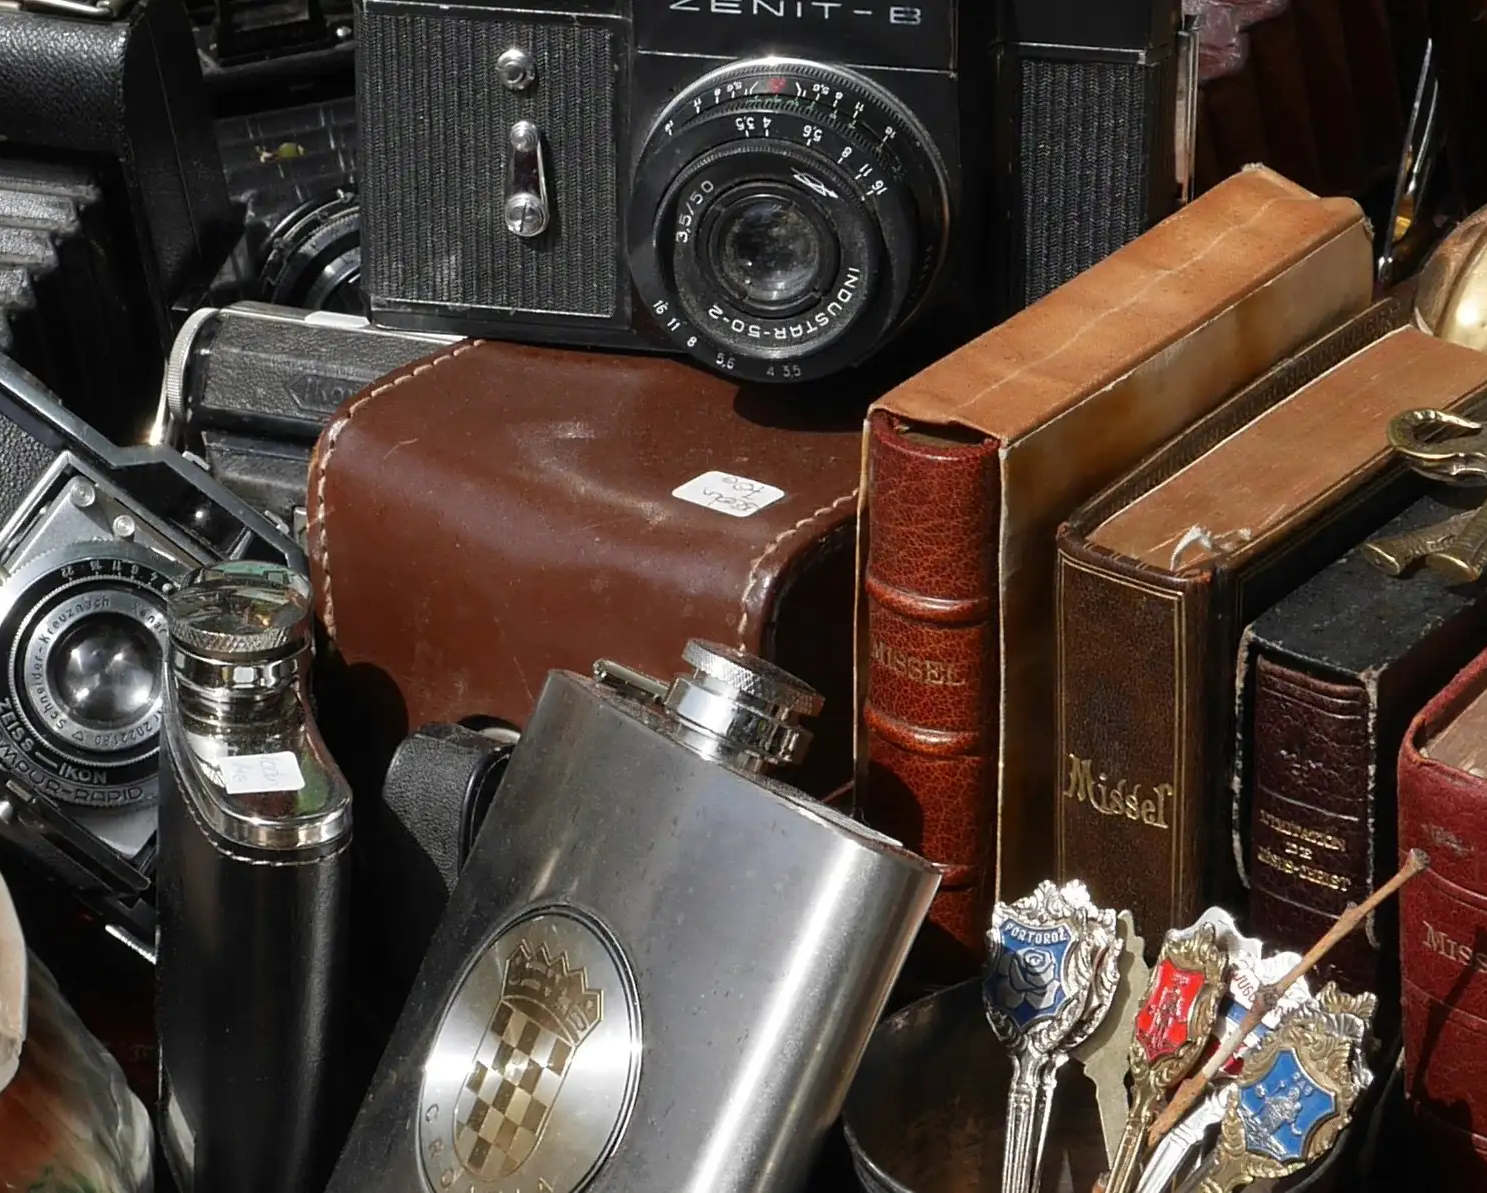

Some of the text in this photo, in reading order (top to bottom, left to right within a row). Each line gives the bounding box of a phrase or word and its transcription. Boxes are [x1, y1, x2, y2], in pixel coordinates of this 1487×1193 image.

[735, 115, 888, 196] 16 11 8 5,6 4 3,5
[676, 180, 714, 244] 3,5/50
[653, 299, 802, 379] 16 11 8 5,6 4 3,5
[708, 266, 860, 340] INDUSTAR-50-2
[58, 762, 108, 784] IKON
[1062, 753, 1174, 829] Missel
